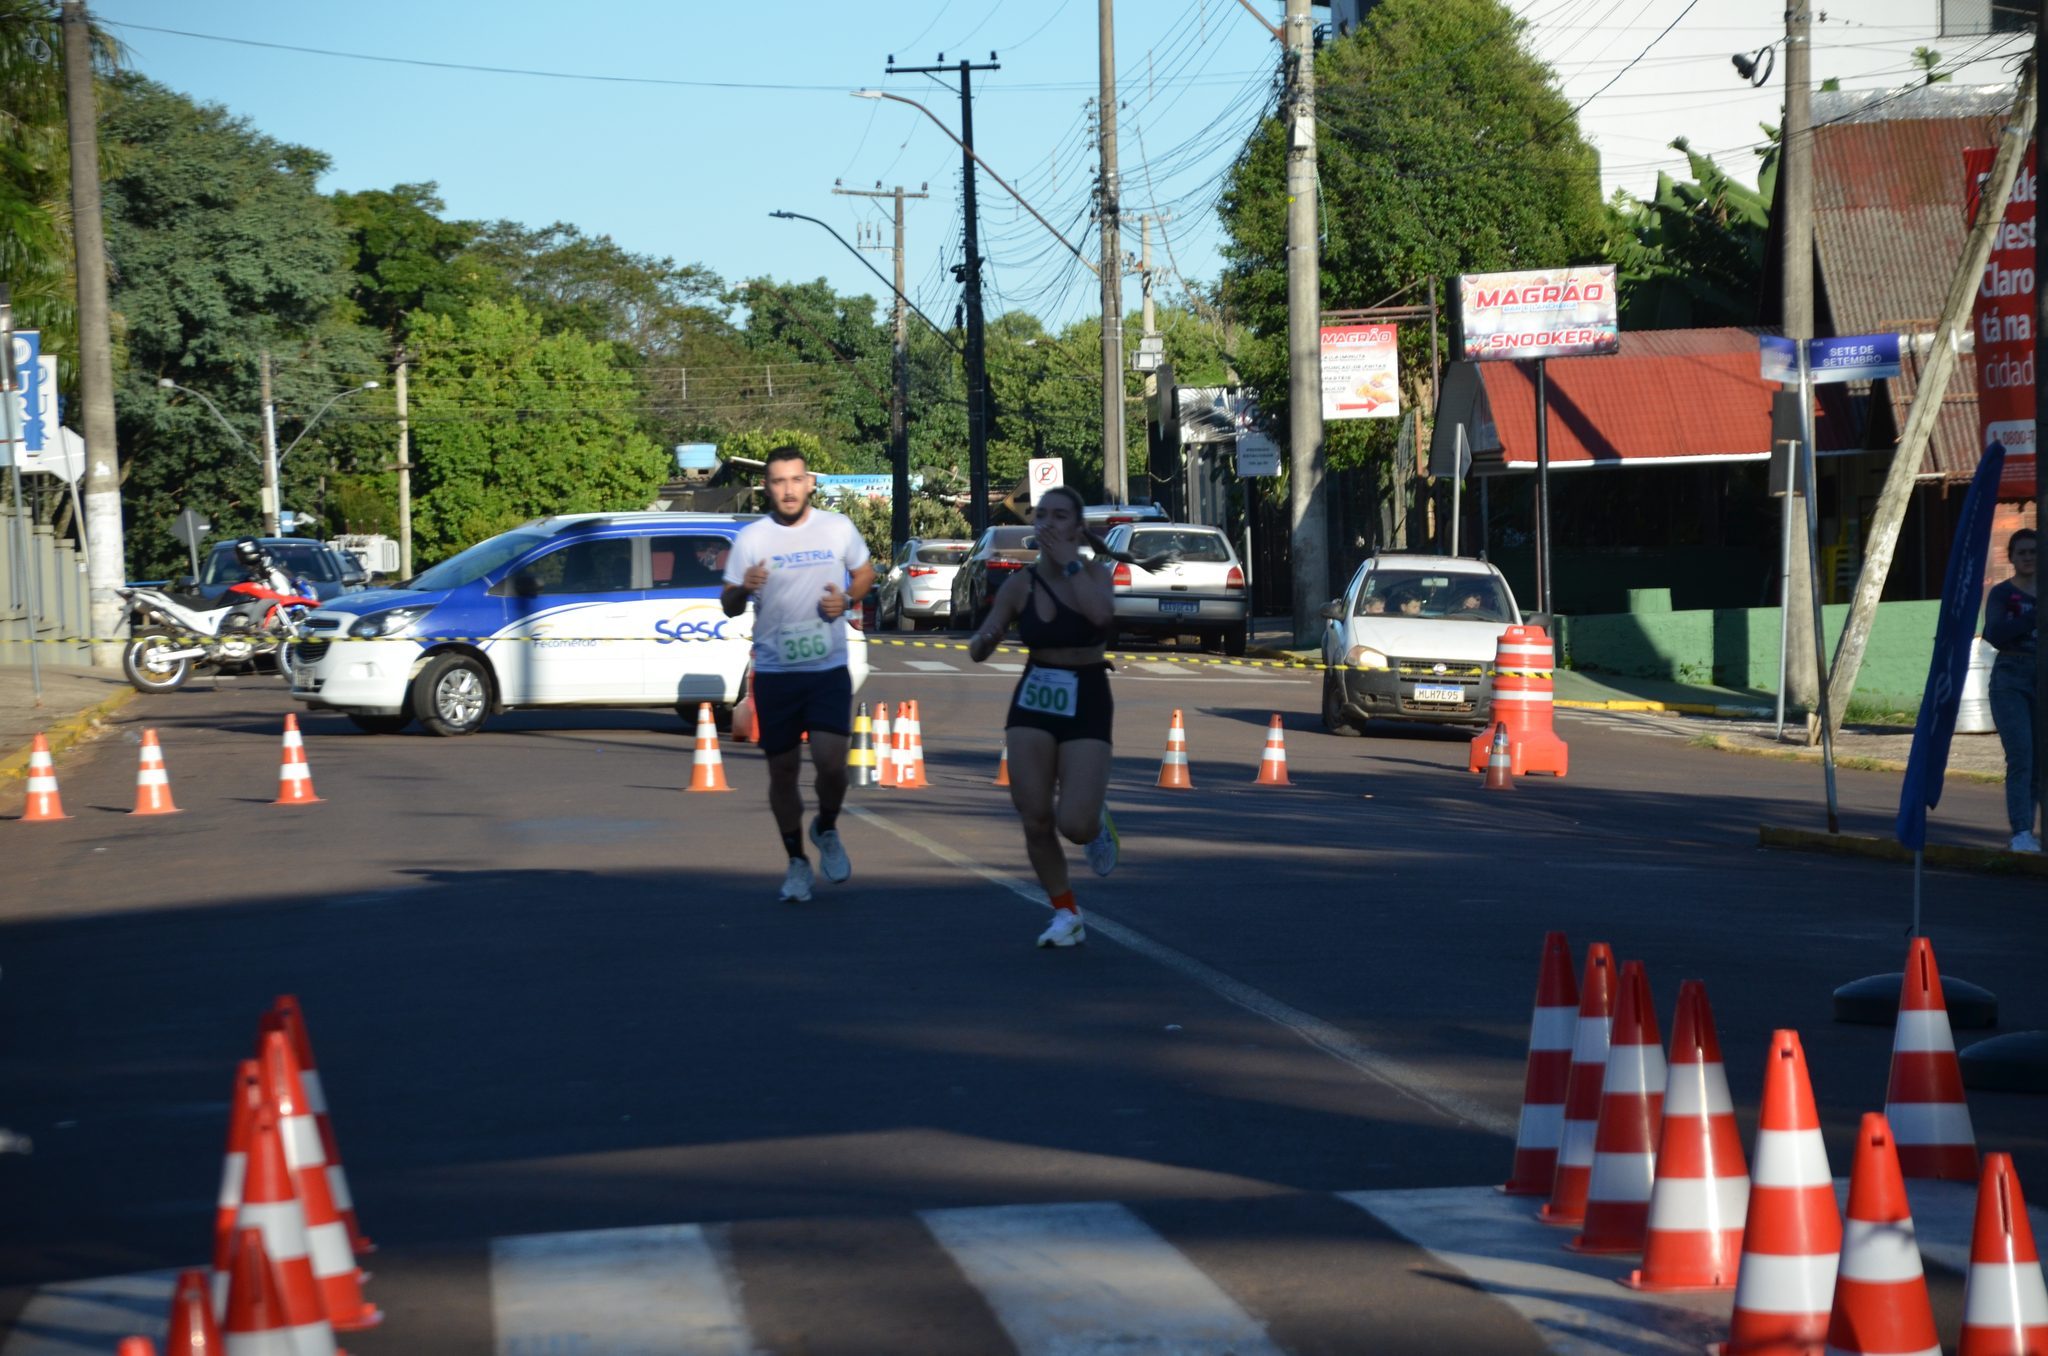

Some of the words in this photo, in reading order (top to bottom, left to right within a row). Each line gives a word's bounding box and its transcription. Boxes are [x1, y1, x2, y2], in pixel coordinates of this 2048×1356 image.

[1981, 261, 2035, 297] Claro
[1476, 278, 1604, 308] MAGRÃO
[1321, 328, 1392, 344] MAGRÃO
[1982, 307, 2001, 342] tá
[2004, 313, 2031, 341] na
[1491, 330, 1594, 348] SNOOKER
[1829, 346, 1857, 357] SETE
[1859, 345, 1875, 355] DE
[1822, 354, 1882, 367] SETEMBRO
[784, 634, 826, 660] 366
[1025, 684, 1069, 711] 500
